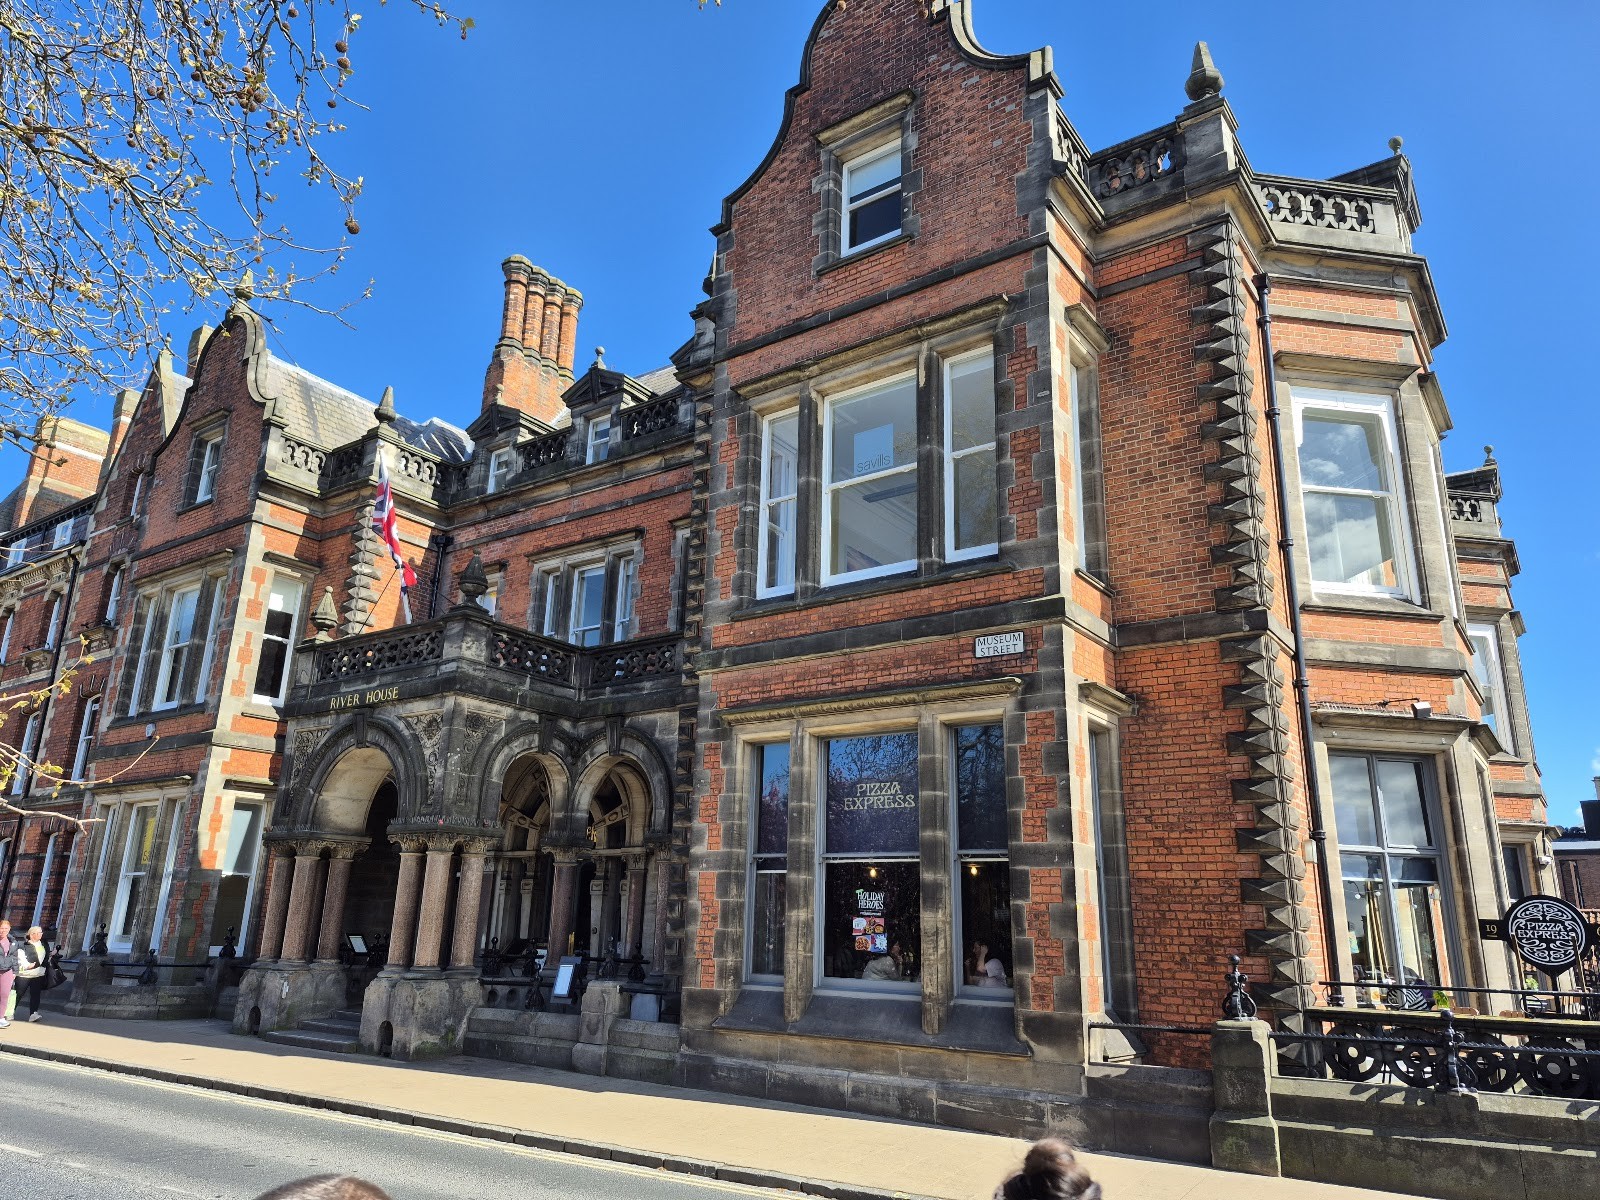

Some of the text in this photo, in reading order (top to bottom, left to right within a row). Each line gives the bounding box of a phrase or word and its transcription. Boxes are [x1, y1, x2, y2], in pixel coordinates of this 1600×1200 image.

[857, 454, 890, 473] savills
[978, 633, 1021, 647] MUSEUM
[981, 644, 1018, 656] STREET
[330, 686, 399, 709] RIVER HOUSE
[856, 781, 902, 796] PIZZA
[844, 794, 916, 811] EXPRESS
[857, 891, 885, 901] HOLIDAY
[858, 900, 884, 910] HEROES
[1485, 924, 1498, 934] 19
[1527, 922, 1565, 932] PIZZA
